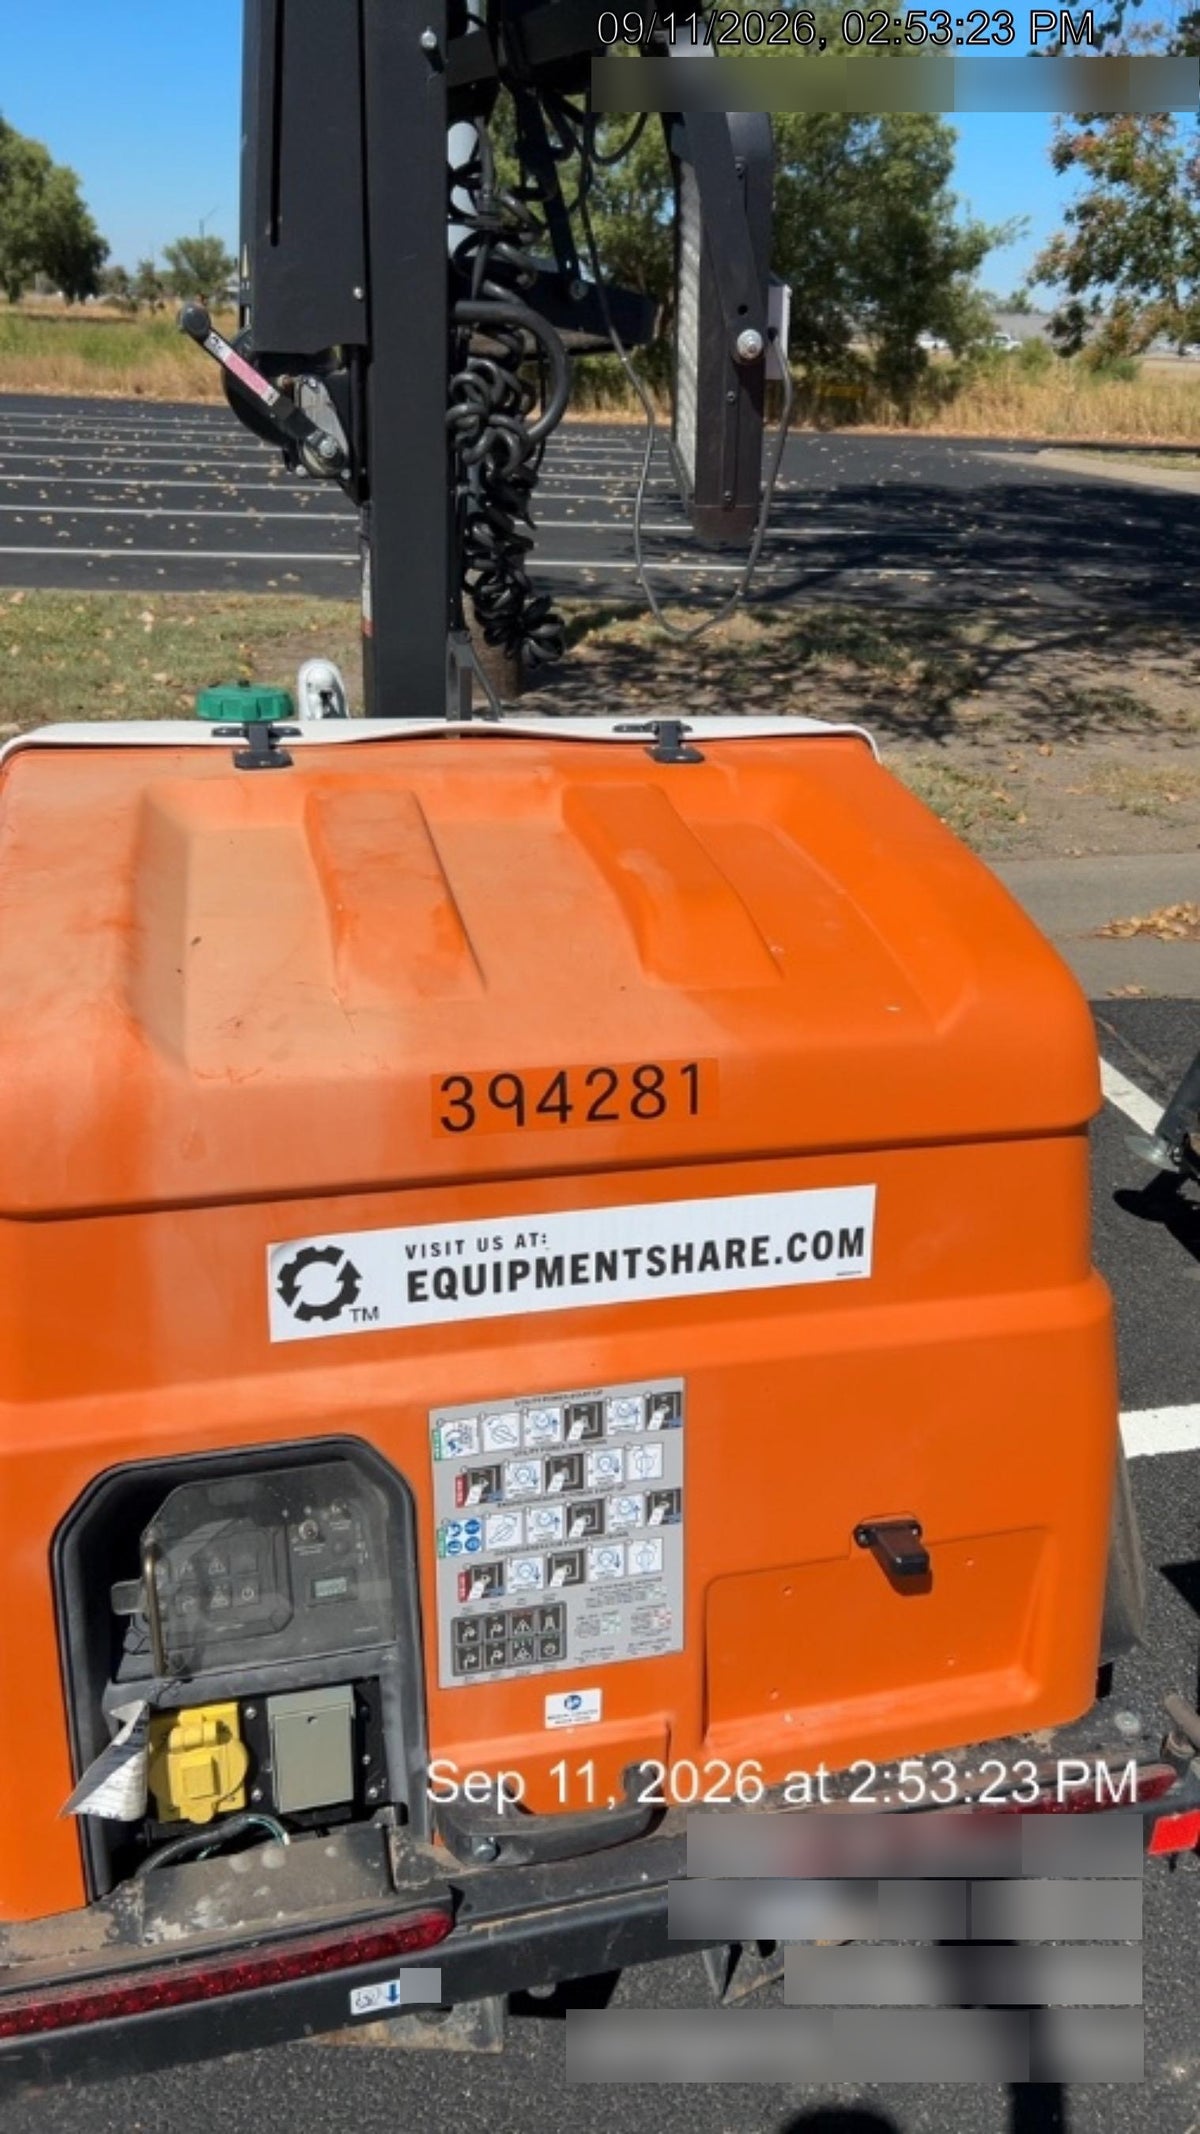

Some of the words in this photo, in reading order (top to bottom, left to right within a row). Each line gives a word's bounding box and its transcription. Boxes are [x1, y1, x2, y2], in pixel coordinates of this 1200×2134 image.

[440, 1063, 698, 1133] 394281
[405, 1240, 465, 1260] VISIT
[477, 1235, 503, 1253] US
[514, 1231, 548, 1250] AT:
[407, 1226, 865, 1303] EQUIPMENTSHARE.COM
[349, 1306, 379, 1323] TM
